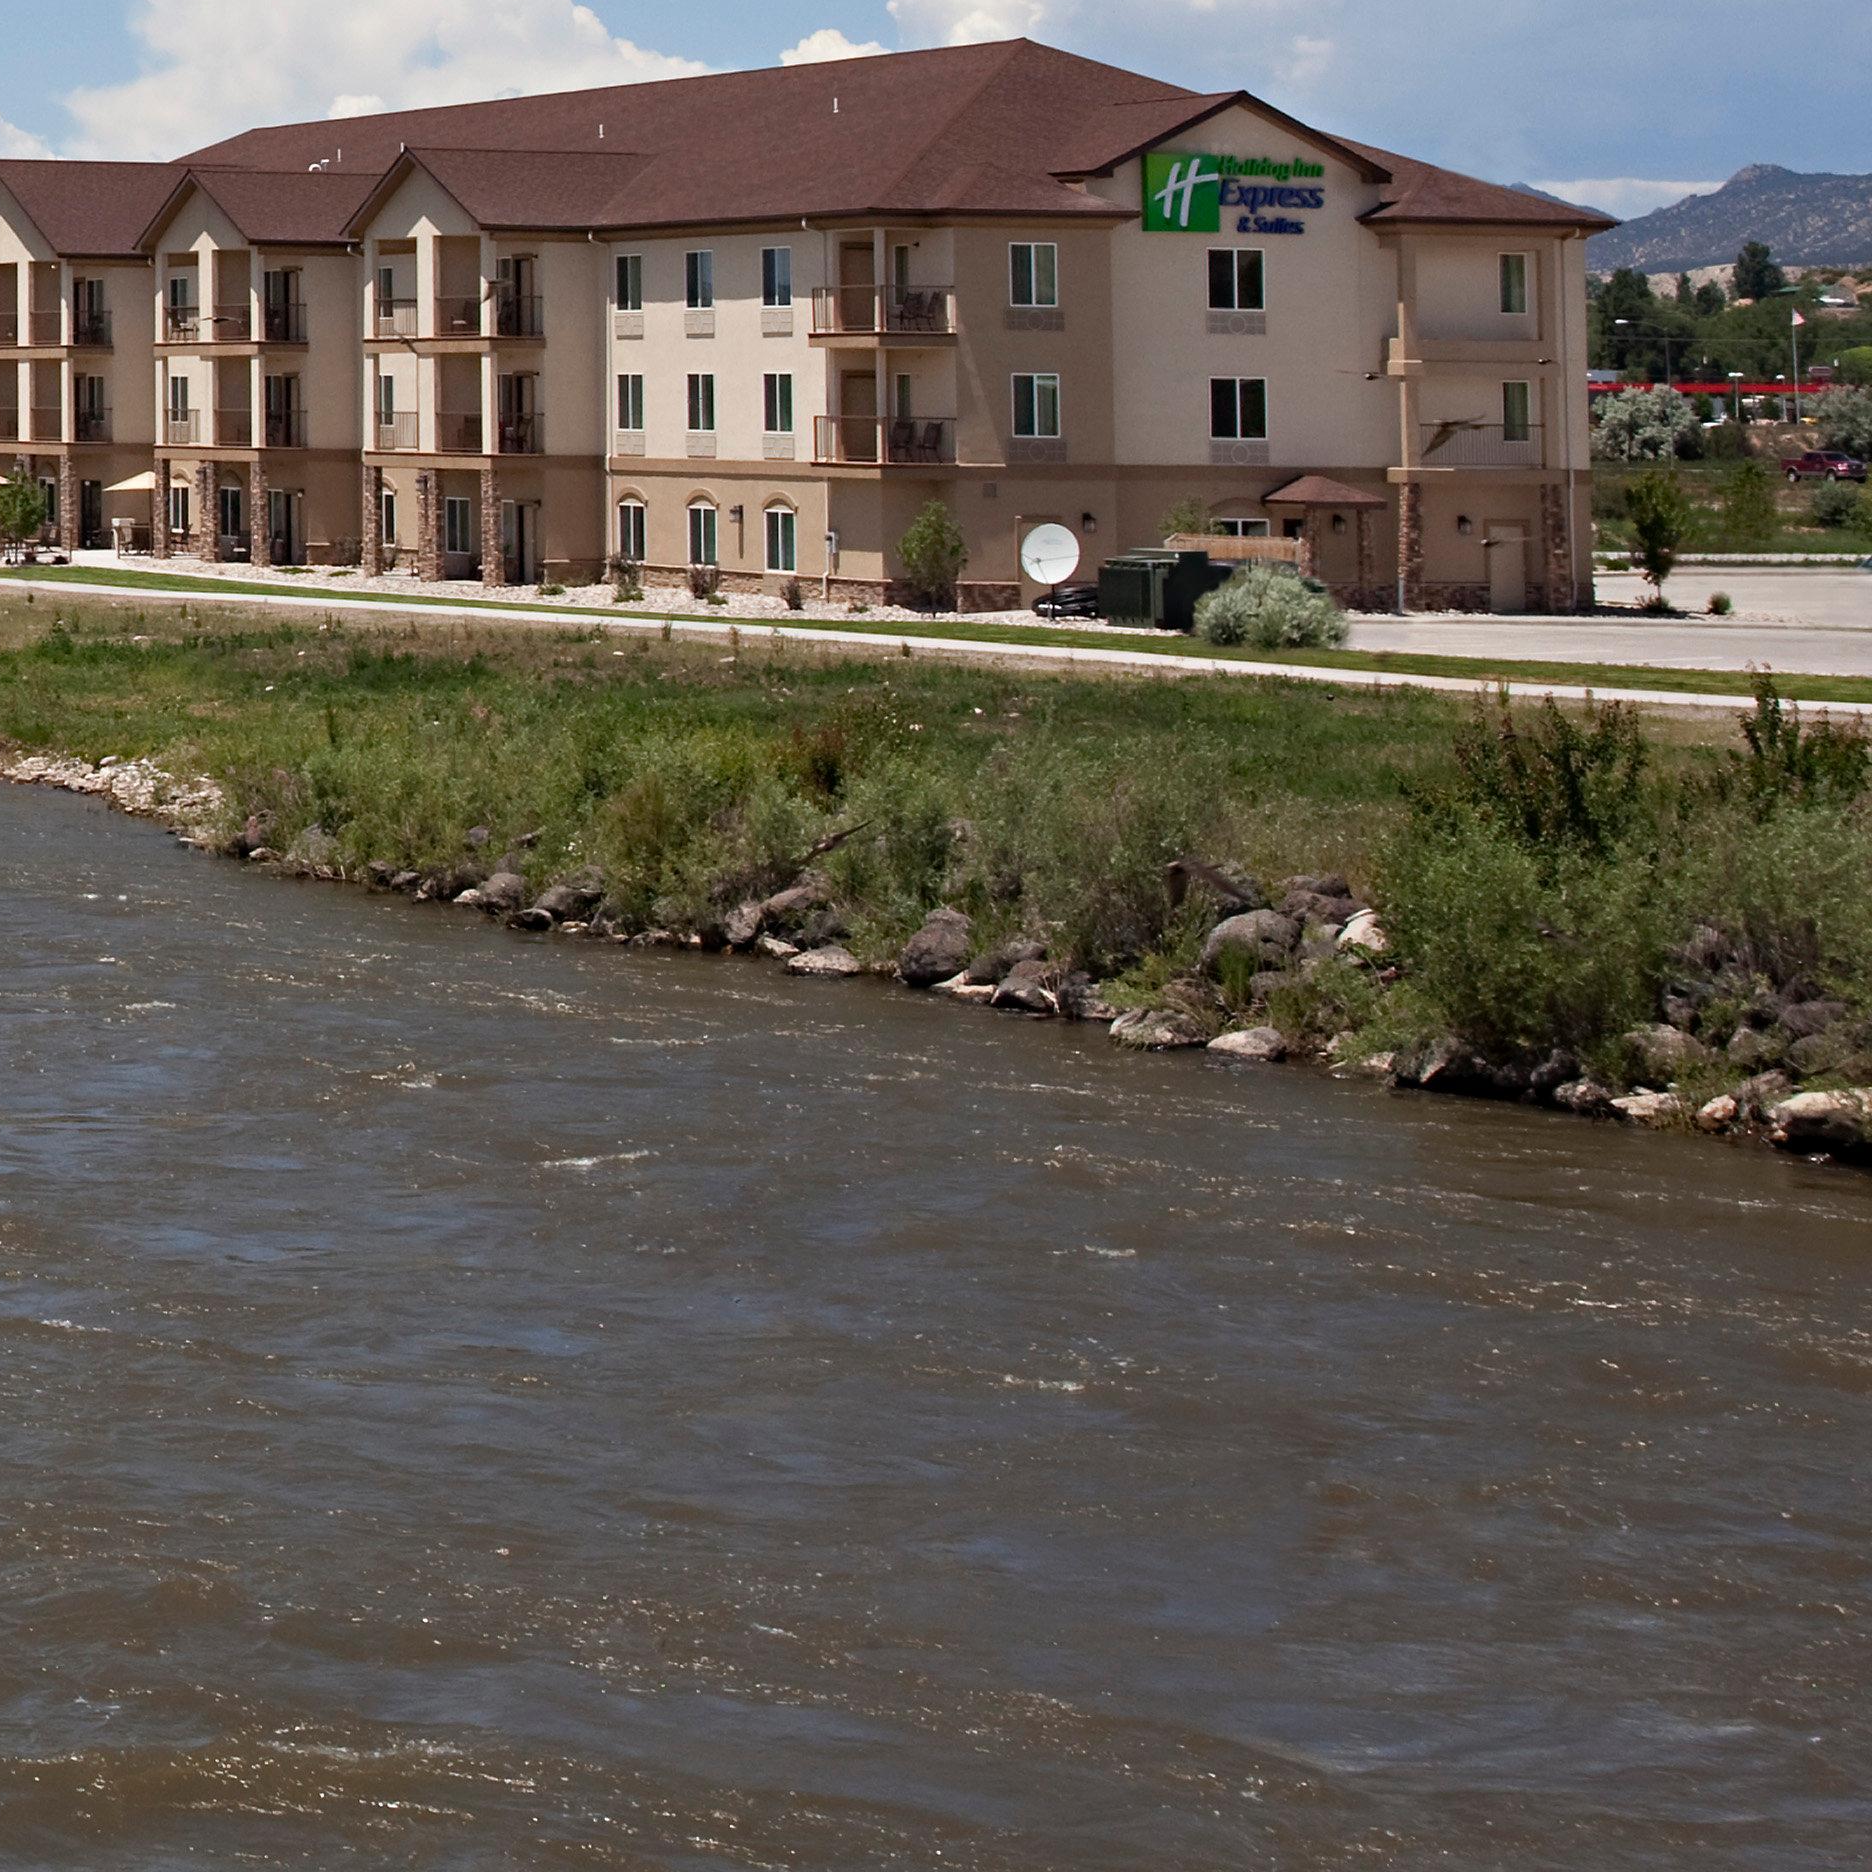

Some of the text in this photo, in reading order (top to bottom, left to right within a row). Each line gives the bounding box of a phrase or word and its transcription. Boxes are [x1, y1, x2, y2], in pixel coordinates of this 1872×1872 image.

[1292, 157, 1324, 177] Inn
[1219, 178, 1324, 214] Express
[1237, 216, 1304, 234] & Suites
